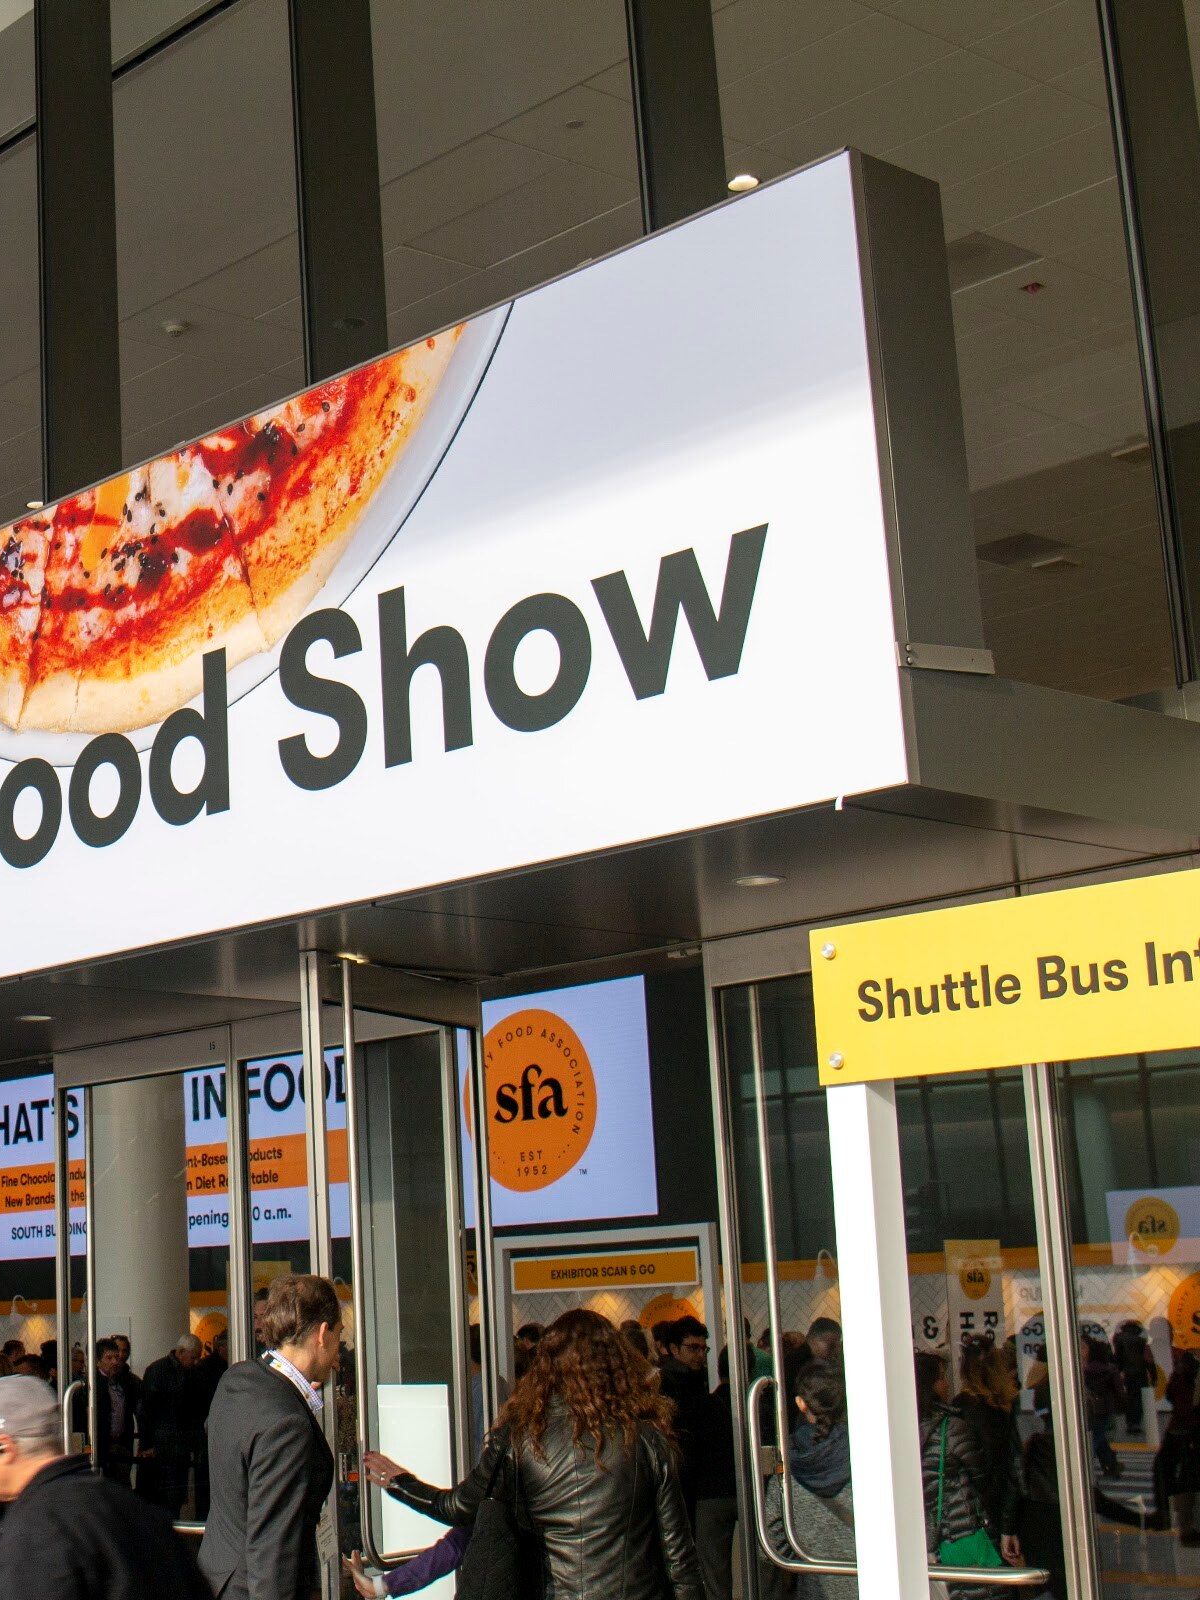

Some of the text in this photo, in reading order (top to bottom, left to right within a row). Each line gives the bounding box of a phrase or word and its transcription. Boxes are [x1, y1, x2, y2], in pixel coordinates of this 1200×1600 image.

[277, 523, 769, 792] Show
[858, 964, 1021, 1022] Shuttle
[1037, 955, 1129, 1000] Bus
[191, 1073, 226, 1121] IN
[494, 1064, 568, 1124] sfa
[498, 1026, 584, 1135] FOOD ASSOCIATION
[1, 1175, 18, 1188] Fine
[20, 1169, 56, 1185] Chocola
[248, 1147, 282, 1163] oducts
[517, 1165, 547, 1177] 1952
[520, 1151, 542, 1161] EST
[5, 1196, 23, 1208] New
[25, 1192, 55, 1206] Brands
[71, 1190, 85, 1202] the
[196, 1175, 215, 1190] Diet
[11, 1226, 43, 1240] SOUTH
[188, 1209, 229, 1229] pening
[264, 1208, 292, 1221] a.m.
[551, 1264, 655, 1280] EXHIBITOR SCAN & GO
[966, 1268, 985, 1283] sfa
